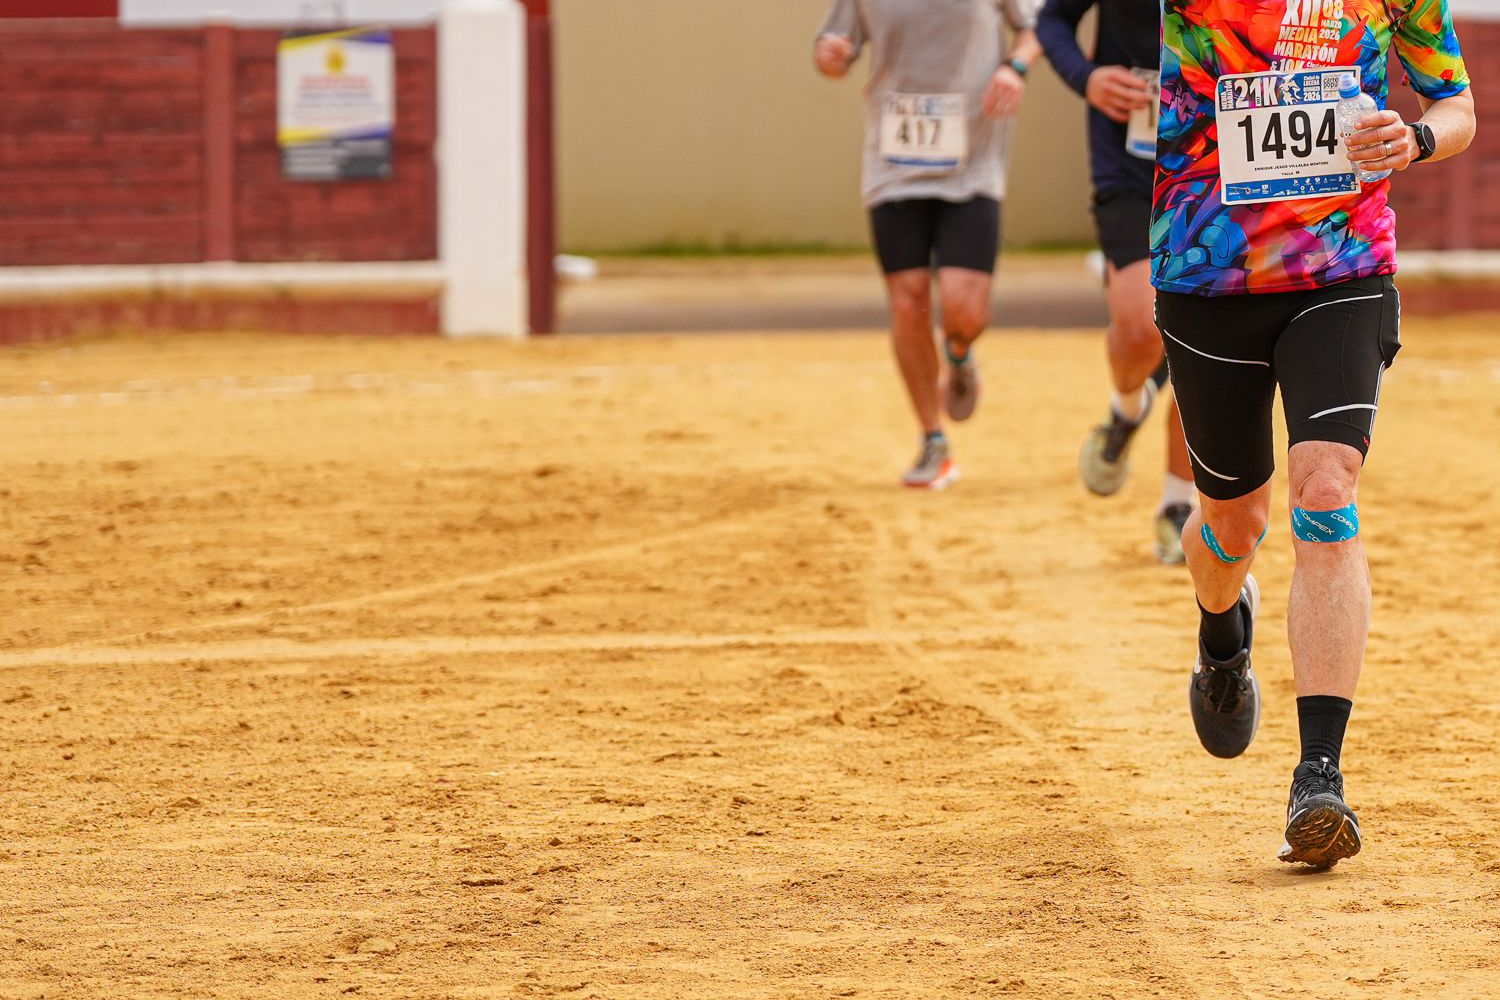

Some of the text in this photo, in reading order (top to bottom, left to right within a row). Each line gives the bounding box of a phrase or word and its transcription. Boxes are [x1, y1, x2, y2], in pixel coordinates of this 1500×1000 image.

[1278, 25, 1318, 44] MEDIA
[1319, 28, 1341, 41] 2026
[1320, 19, 1342, 29] MARZO
[1273, 41, 1338, 63] MARATÓN
[1234, 76, 1279, 109] 21K
[1303, 91, 1321, 102] 2026
[895, 117, 942, 146] 417
[1237, 108, 1338, 162] 1494
[1300, 508, 1335, 535] COMPEX
